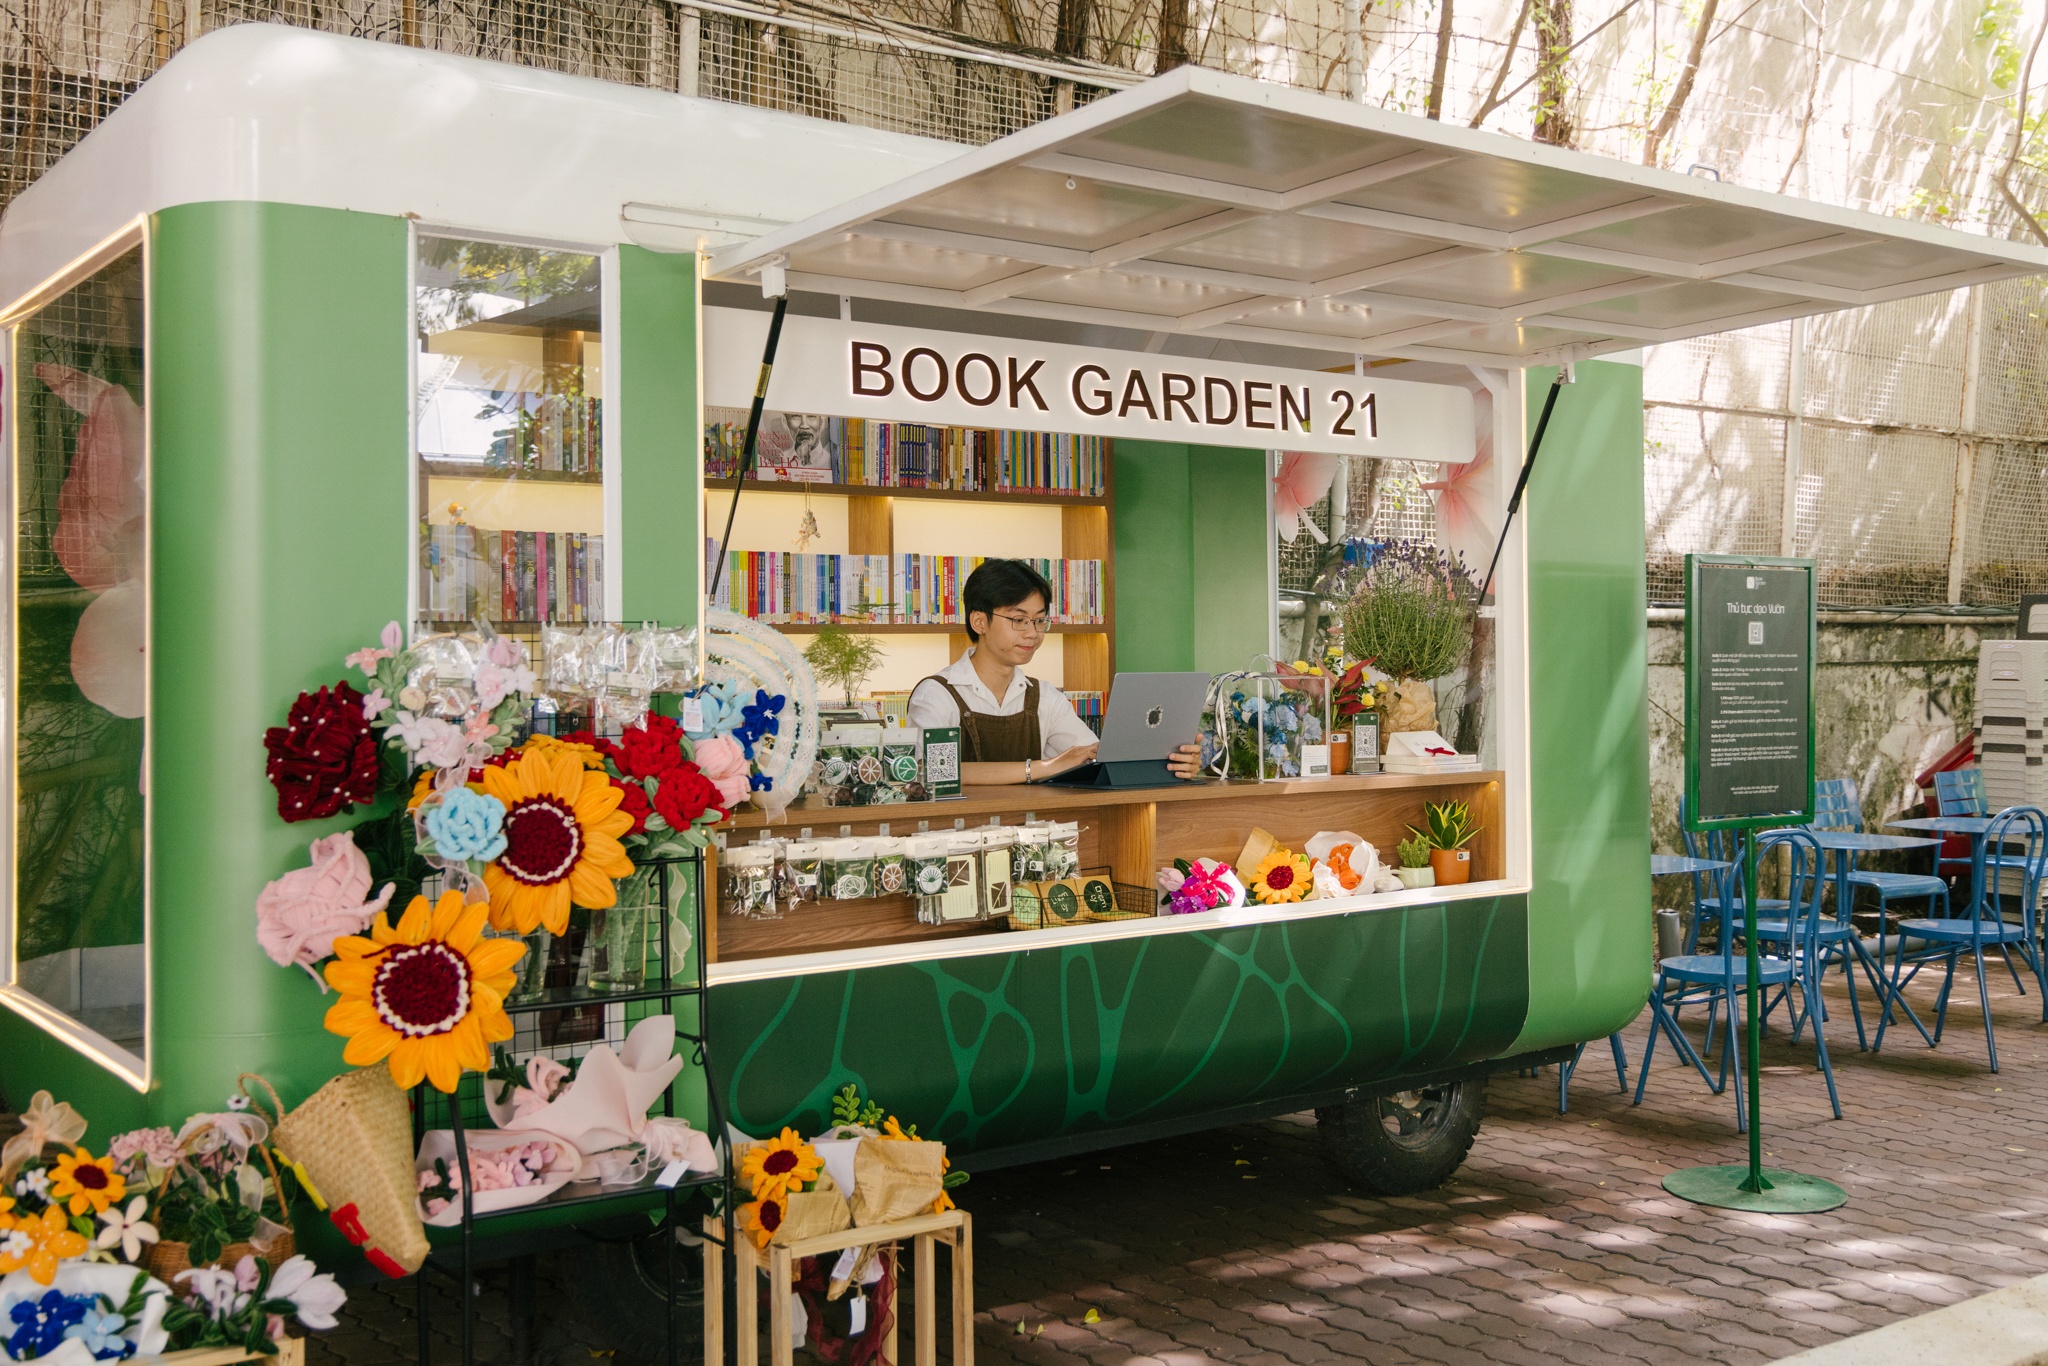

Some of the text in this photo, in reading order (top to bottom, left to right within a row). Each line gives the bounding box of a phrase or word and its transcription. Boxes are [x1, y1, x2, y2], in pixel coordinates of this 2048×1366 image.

[851, 341, 1377, 438] BOOK GARDEN 21
[527, 560, 536, 590] HOLLY
[1726, 602, 1739, 613] Thủ
[1741, 603, 1752, 615] tục
